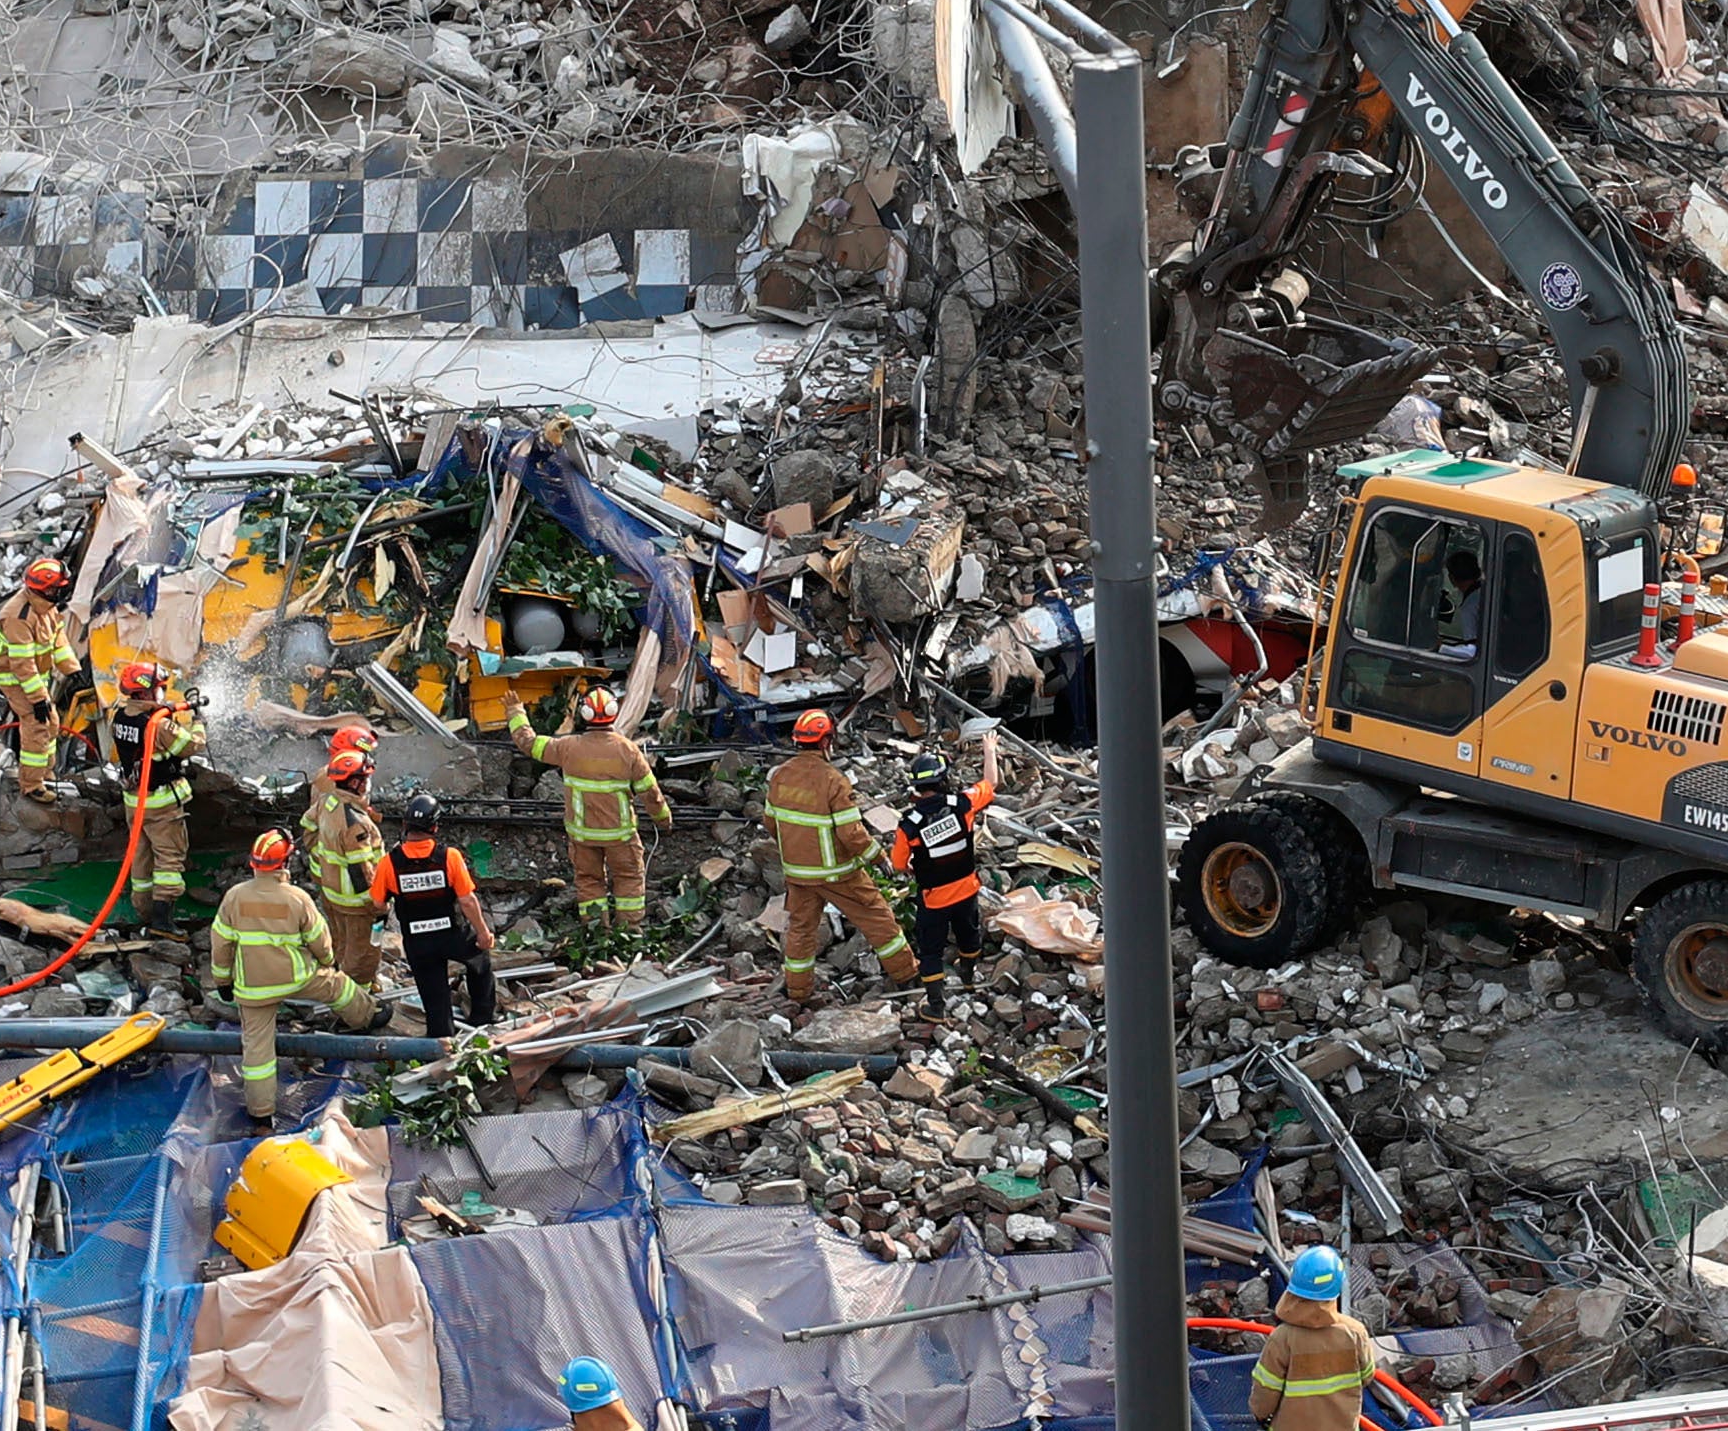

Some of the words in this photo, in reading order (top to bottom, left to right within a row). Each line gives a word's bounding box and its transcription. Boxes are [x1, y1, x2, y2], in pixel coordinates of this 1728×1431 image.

[1402, 72, 1509, 210] VOLVO
[1493, 674, 1519, 685] VOLVO
[1588, 720, 1687, 757] VOLVO
[1493, 758, 1532, 774] PRIME
